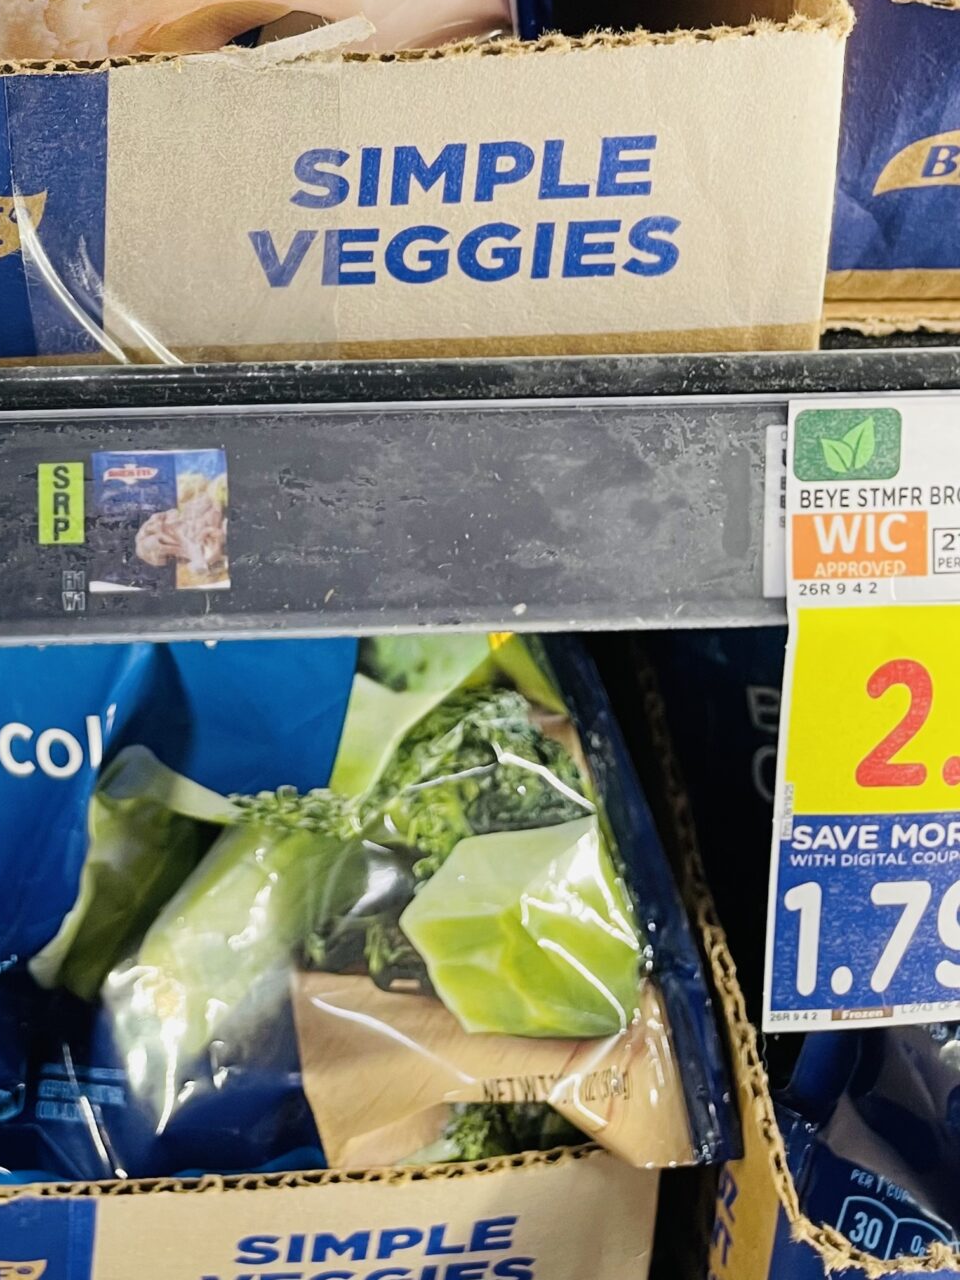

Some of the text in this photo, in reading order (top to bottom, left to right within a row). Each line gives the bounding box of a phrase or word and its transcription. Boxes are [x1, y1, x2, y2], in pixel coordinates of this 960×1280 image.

[289, 134, 658, 208] SIMPLE
[248, 216, 682, 288] VEGGIES
[800, 486, 960, 508] BEYE STMFR BR
[813, 513, 908, 554] WIC
[814, 559, 907, 578] APPROVED
[799, 582, 878, 596] 26R 9 4 2
[791, 825, 880, 850] SAVE
[790, 853, 836, 867] WITH
[841, 853, 907, 866] DIGITAL
[841, 1010, 884, 1020] Frozen
[234, 1215, 520, 1265] SIMPLE
[849, 1211, 883, 1250] 30
